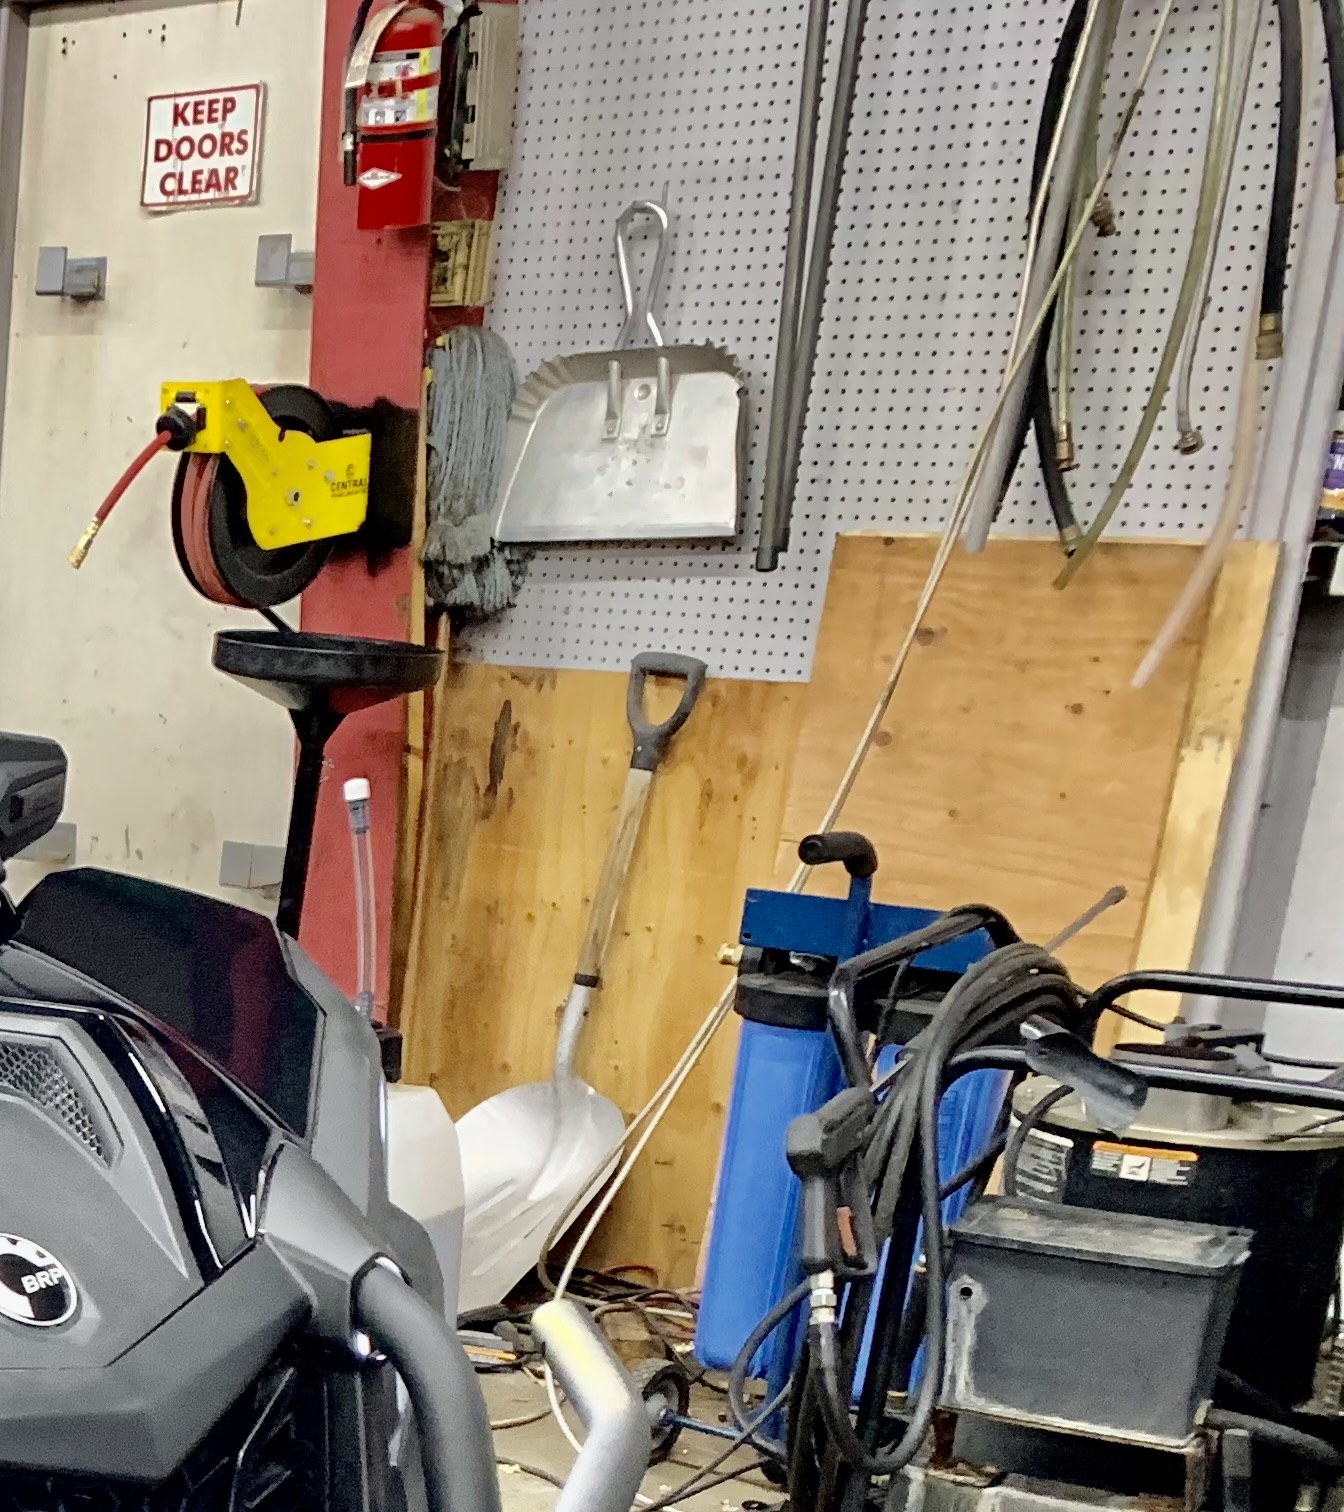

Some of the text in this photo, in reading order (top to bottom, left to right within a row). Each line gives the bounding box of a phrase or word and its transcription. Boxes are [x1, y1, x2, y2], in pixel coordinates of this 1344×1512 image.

[172, 96, 237, 127] KEEP
[153, 128, 249, 163] DOORS
[159, 165, 239, 197] CLEAR
[331, 478, 368, 492] CENTRAL
[20, 1267, 66, 1295] BRP
